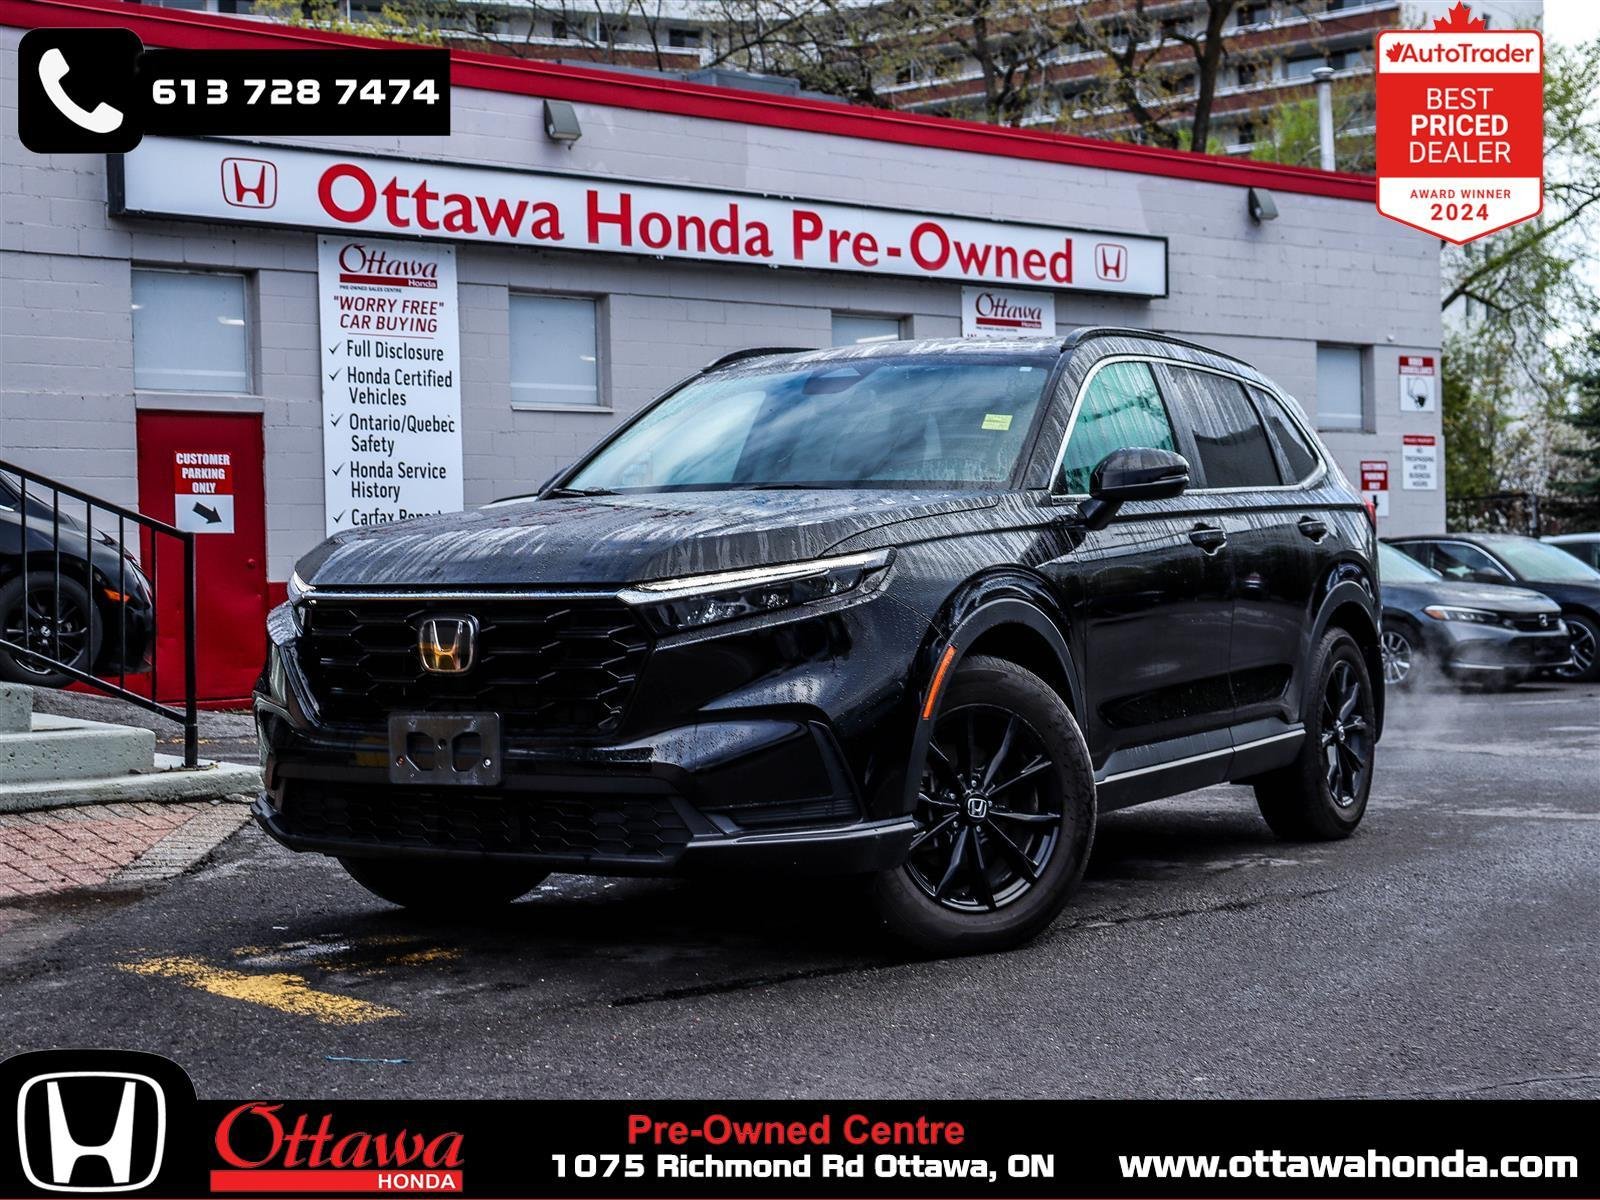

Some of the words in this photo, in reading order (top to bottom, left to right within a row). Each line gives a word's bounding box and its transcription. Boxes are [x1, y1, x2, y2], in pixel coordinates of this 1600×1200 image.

[318, 163, 565, 241] Ottawa
[586, 189, 774, 257] Honda
[792, 209, 1073, 284] Pre-Owned
[338, 242, 438, 278] Ottawa
[408, 279, 437, 288] Honda
[975, 292, 1042, 320] Ottawa
[340, 314, 371, 329] CAR
[376, 316, 438, 333] BUYING
[347, 340, 371, 358] Full
[376, 341, 444, 361] Disclosure
[347, 366, 390, 385] Honda
[394, 368, 453, 388] Certified
[349, 387, 407, 406] Vehicles
[349, 412, 455, 434] Ontario/Quebec
[351, 434, 394, 457] Safety
[175, 453, 231, 466] CUSTOMER
[350, 460, 393, 479] Honda
[398, 461, 447, 479] Service
[182, 467, 226, 480] PARKING
[192, 482, 217, 493] ONLY
[351, 481, 401, 503] History
[351, 507, 394, 526] Carfax
